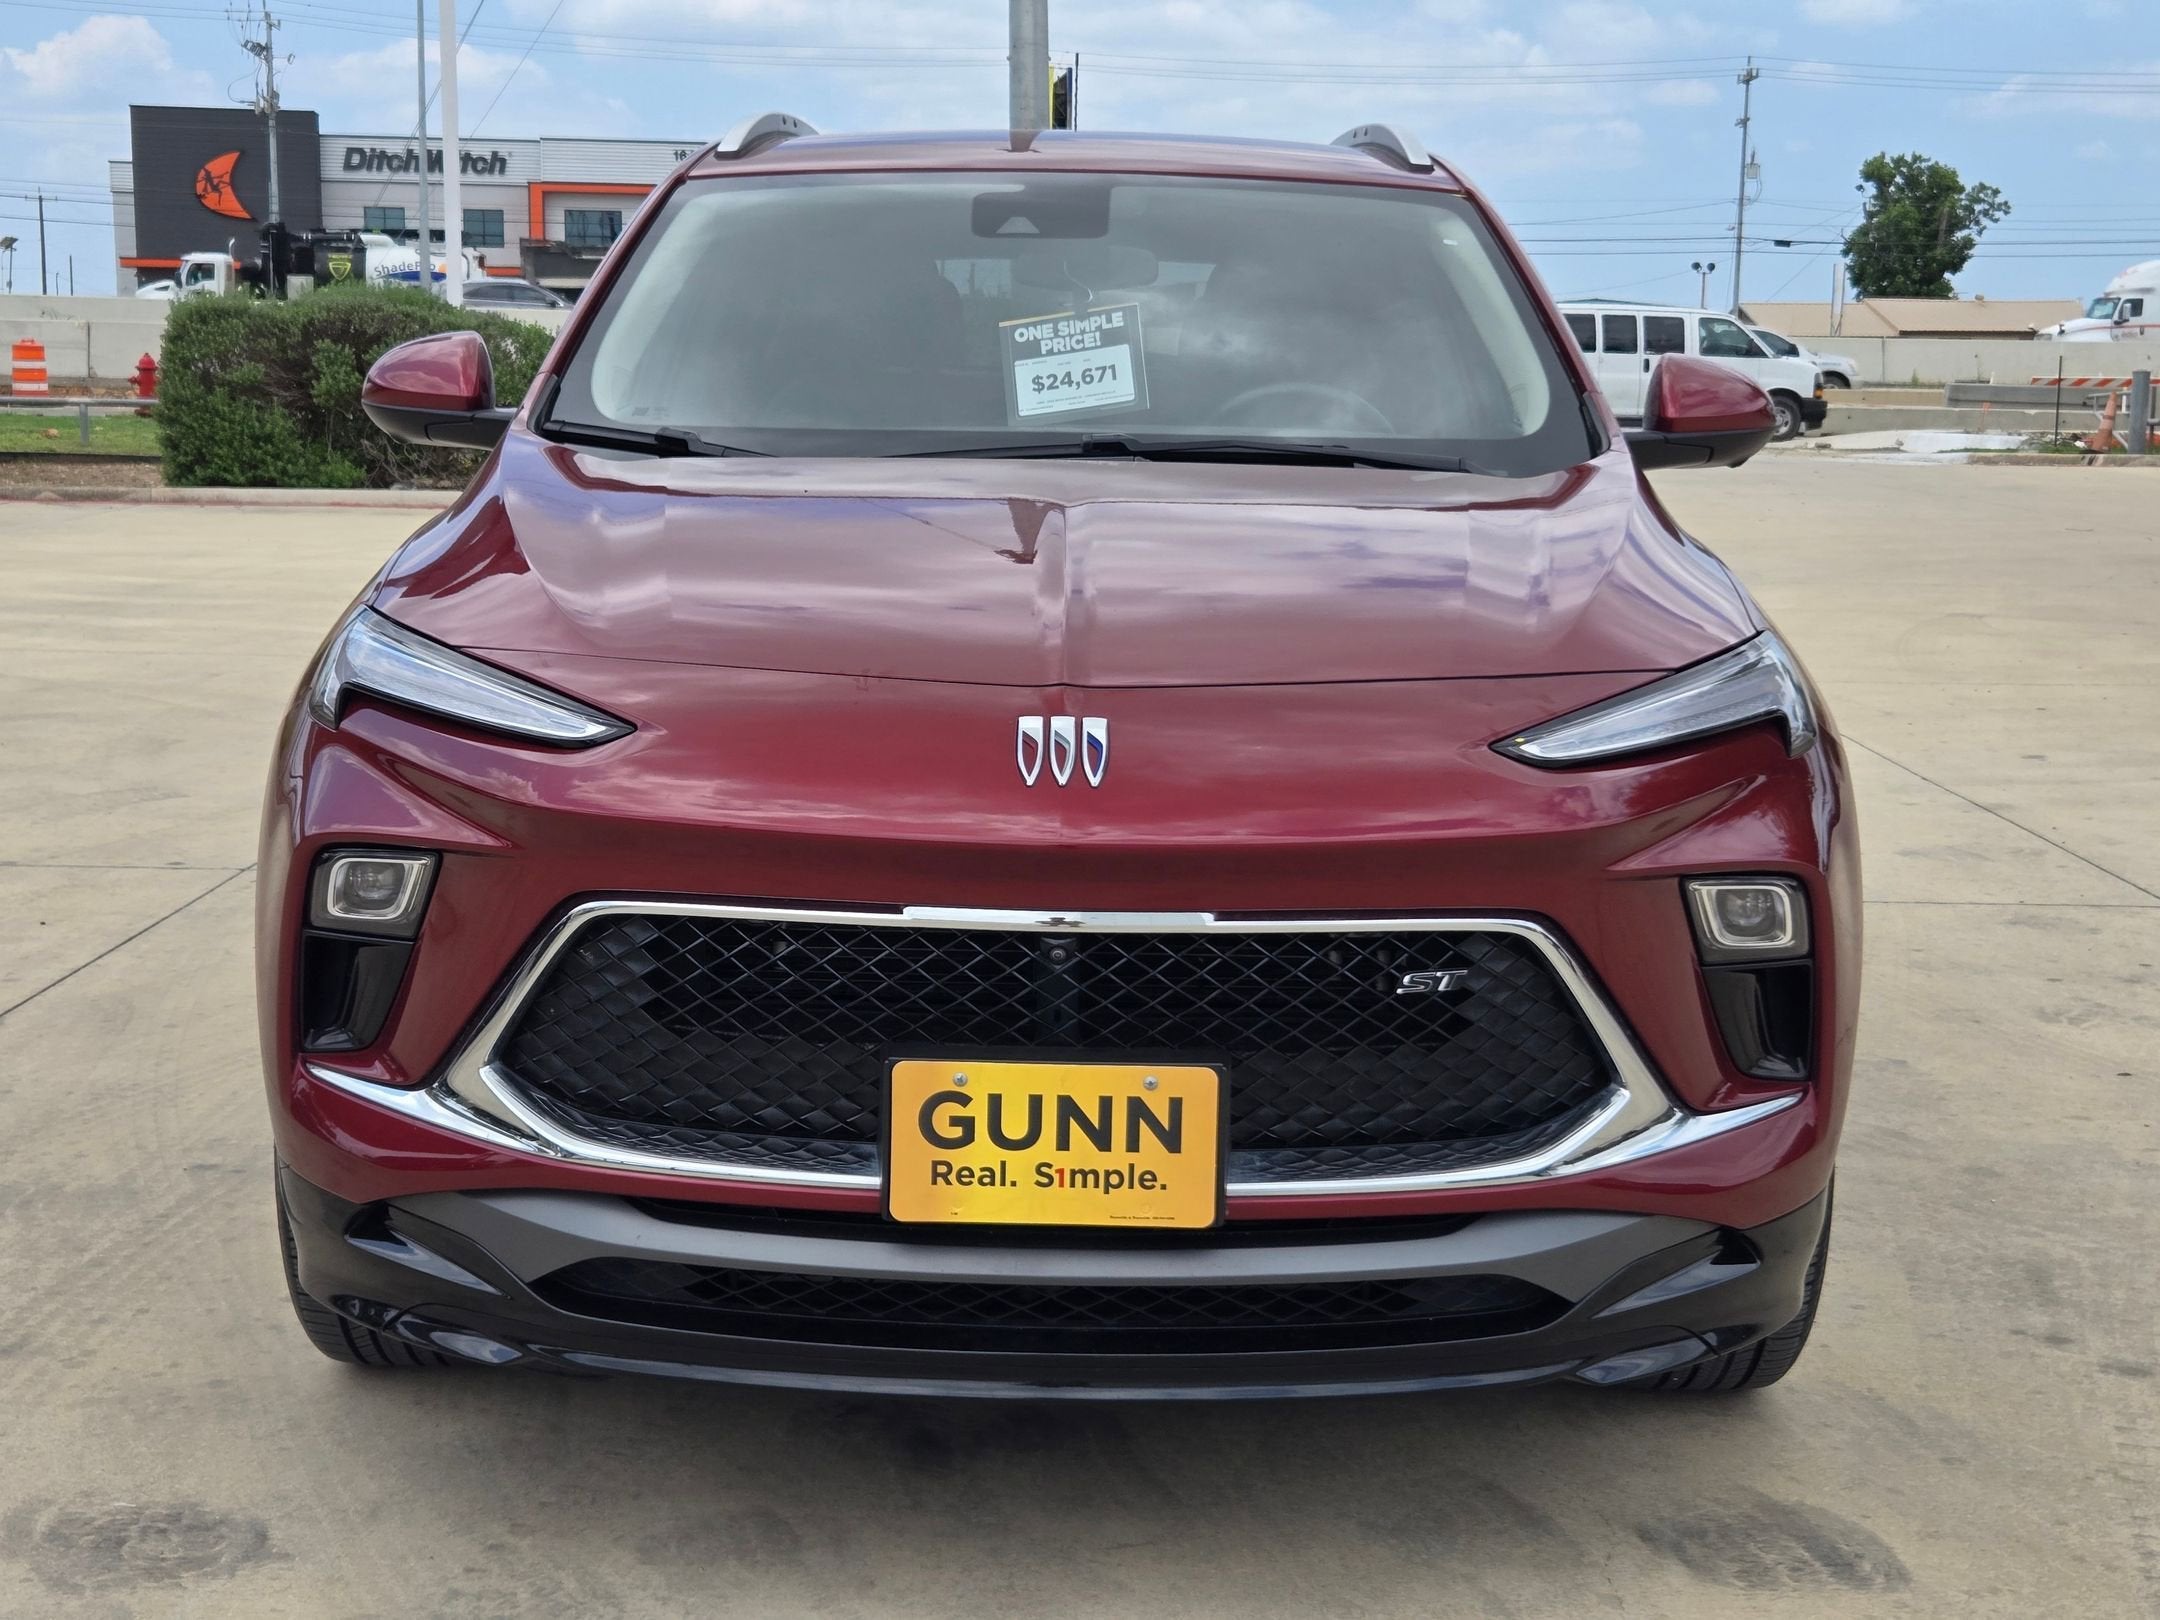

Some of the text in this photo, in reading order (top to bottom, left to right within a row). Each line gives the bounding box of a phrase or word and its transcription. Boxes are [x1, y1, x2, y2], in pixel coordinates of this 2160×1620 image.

[343, 147, 508, 175] Ditch Wtch
[374, 261, 436, 277] ShadePo
[1014, 311, 1124, 343] ONE SIMPLE
[1040, 332, 1101, 355] PRICE!
[1031, 364, 1117, 395] $24,671
[1396, 969, 1468, 995] ST
[917, 1090, 1184, 1154] GUNN
[930, 1160, 1168, 1194] Real. S1mple.
